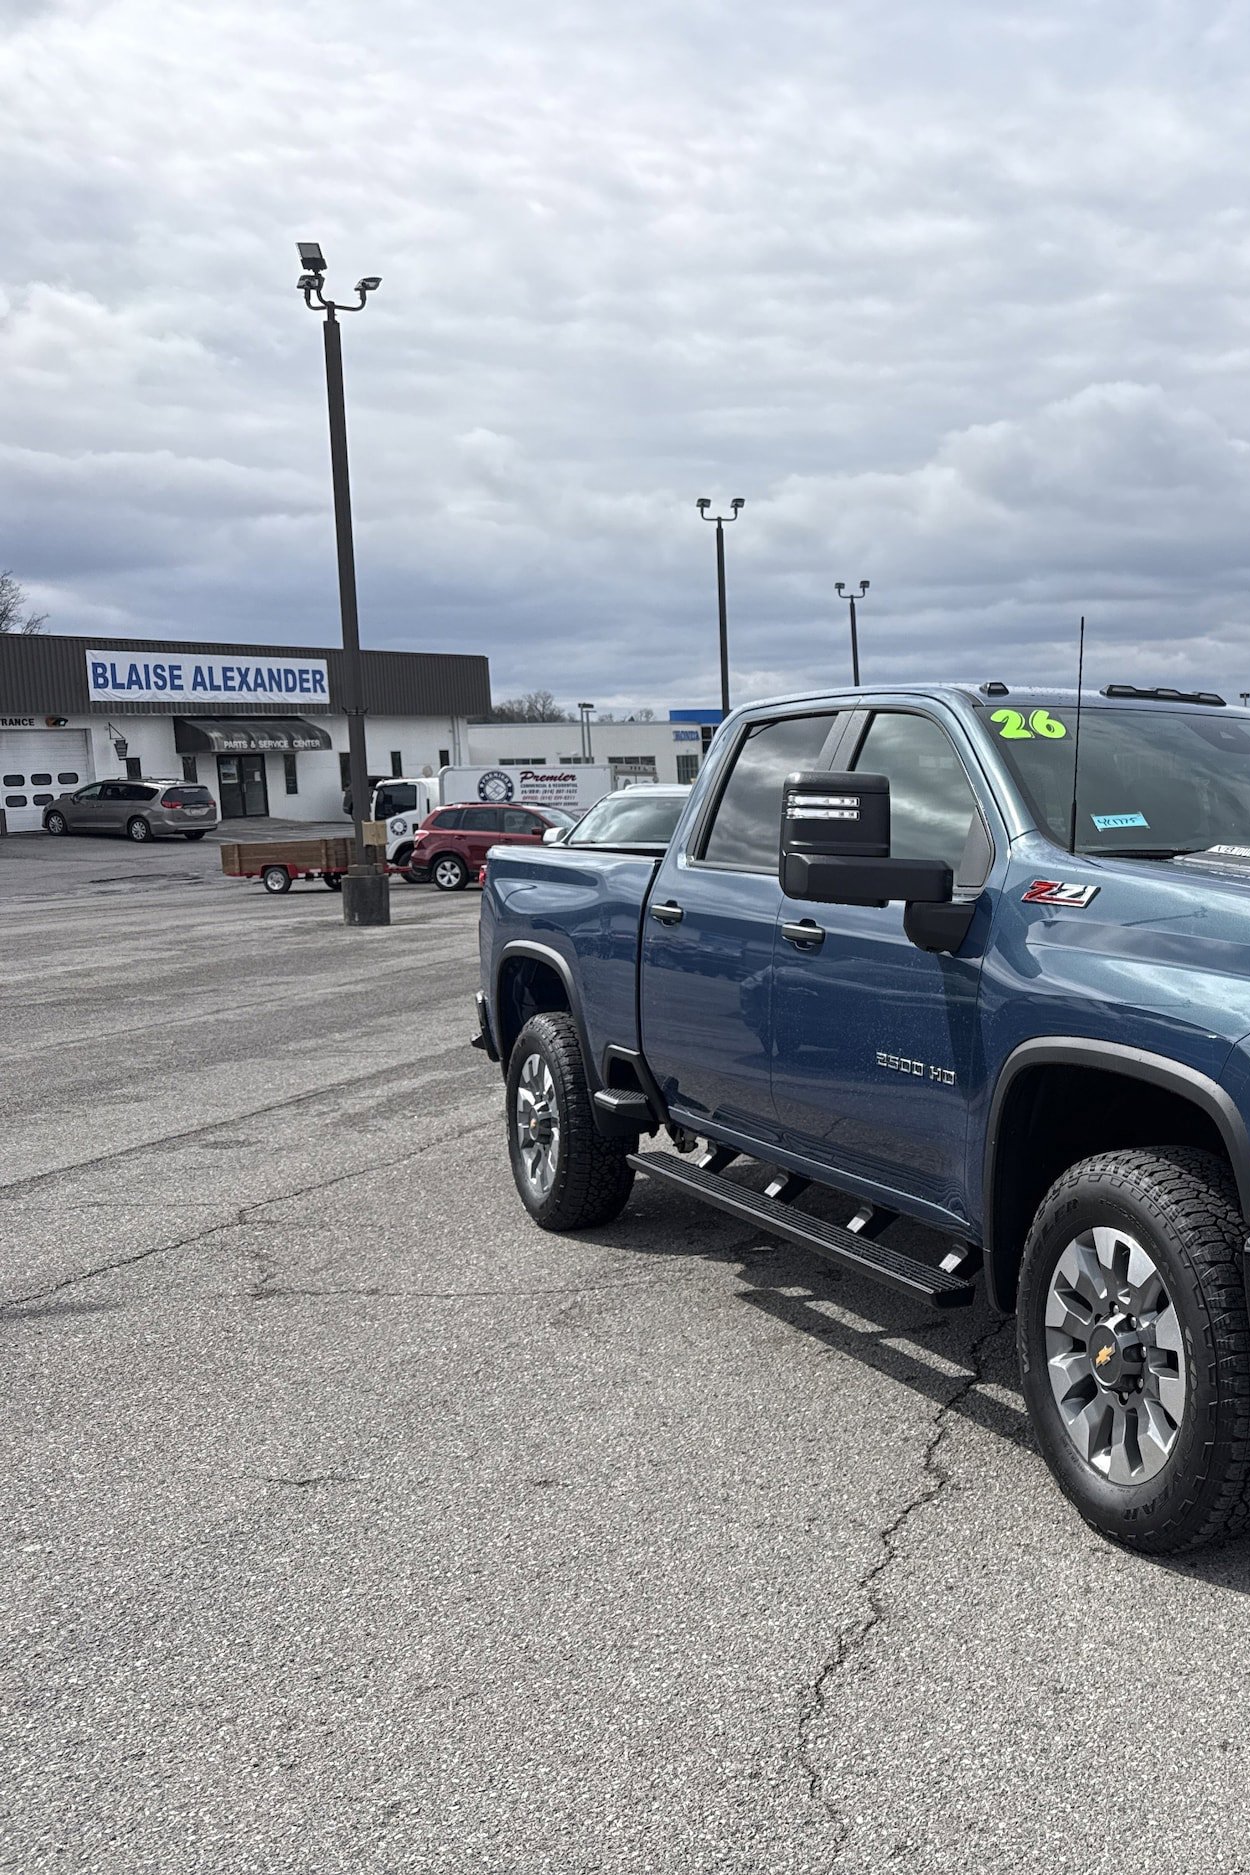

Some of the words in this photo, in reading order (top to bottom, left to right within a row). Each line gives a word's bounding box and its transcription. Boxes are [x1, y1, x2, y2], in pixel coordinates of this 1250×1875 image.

[91, 661, 184, 691] BLAISE
[191, 665, 327, 693] ALEXANDER
[0, 718, 35, 727] RANCE
[990, 708, 1067, 739] 26
[223, 740, 248, 749] PARTS
[250, 740, 256, 748] &
[258, 740, 289, 749] SERVICE
[292, 739, 321, 748] CENTER
[519, 770, 577, 783] Premier
[1021, 879, 1102, 909] Z71
[876, 1051, 924, 1077] 2500
[929, 1065, 956, 1085] HD
